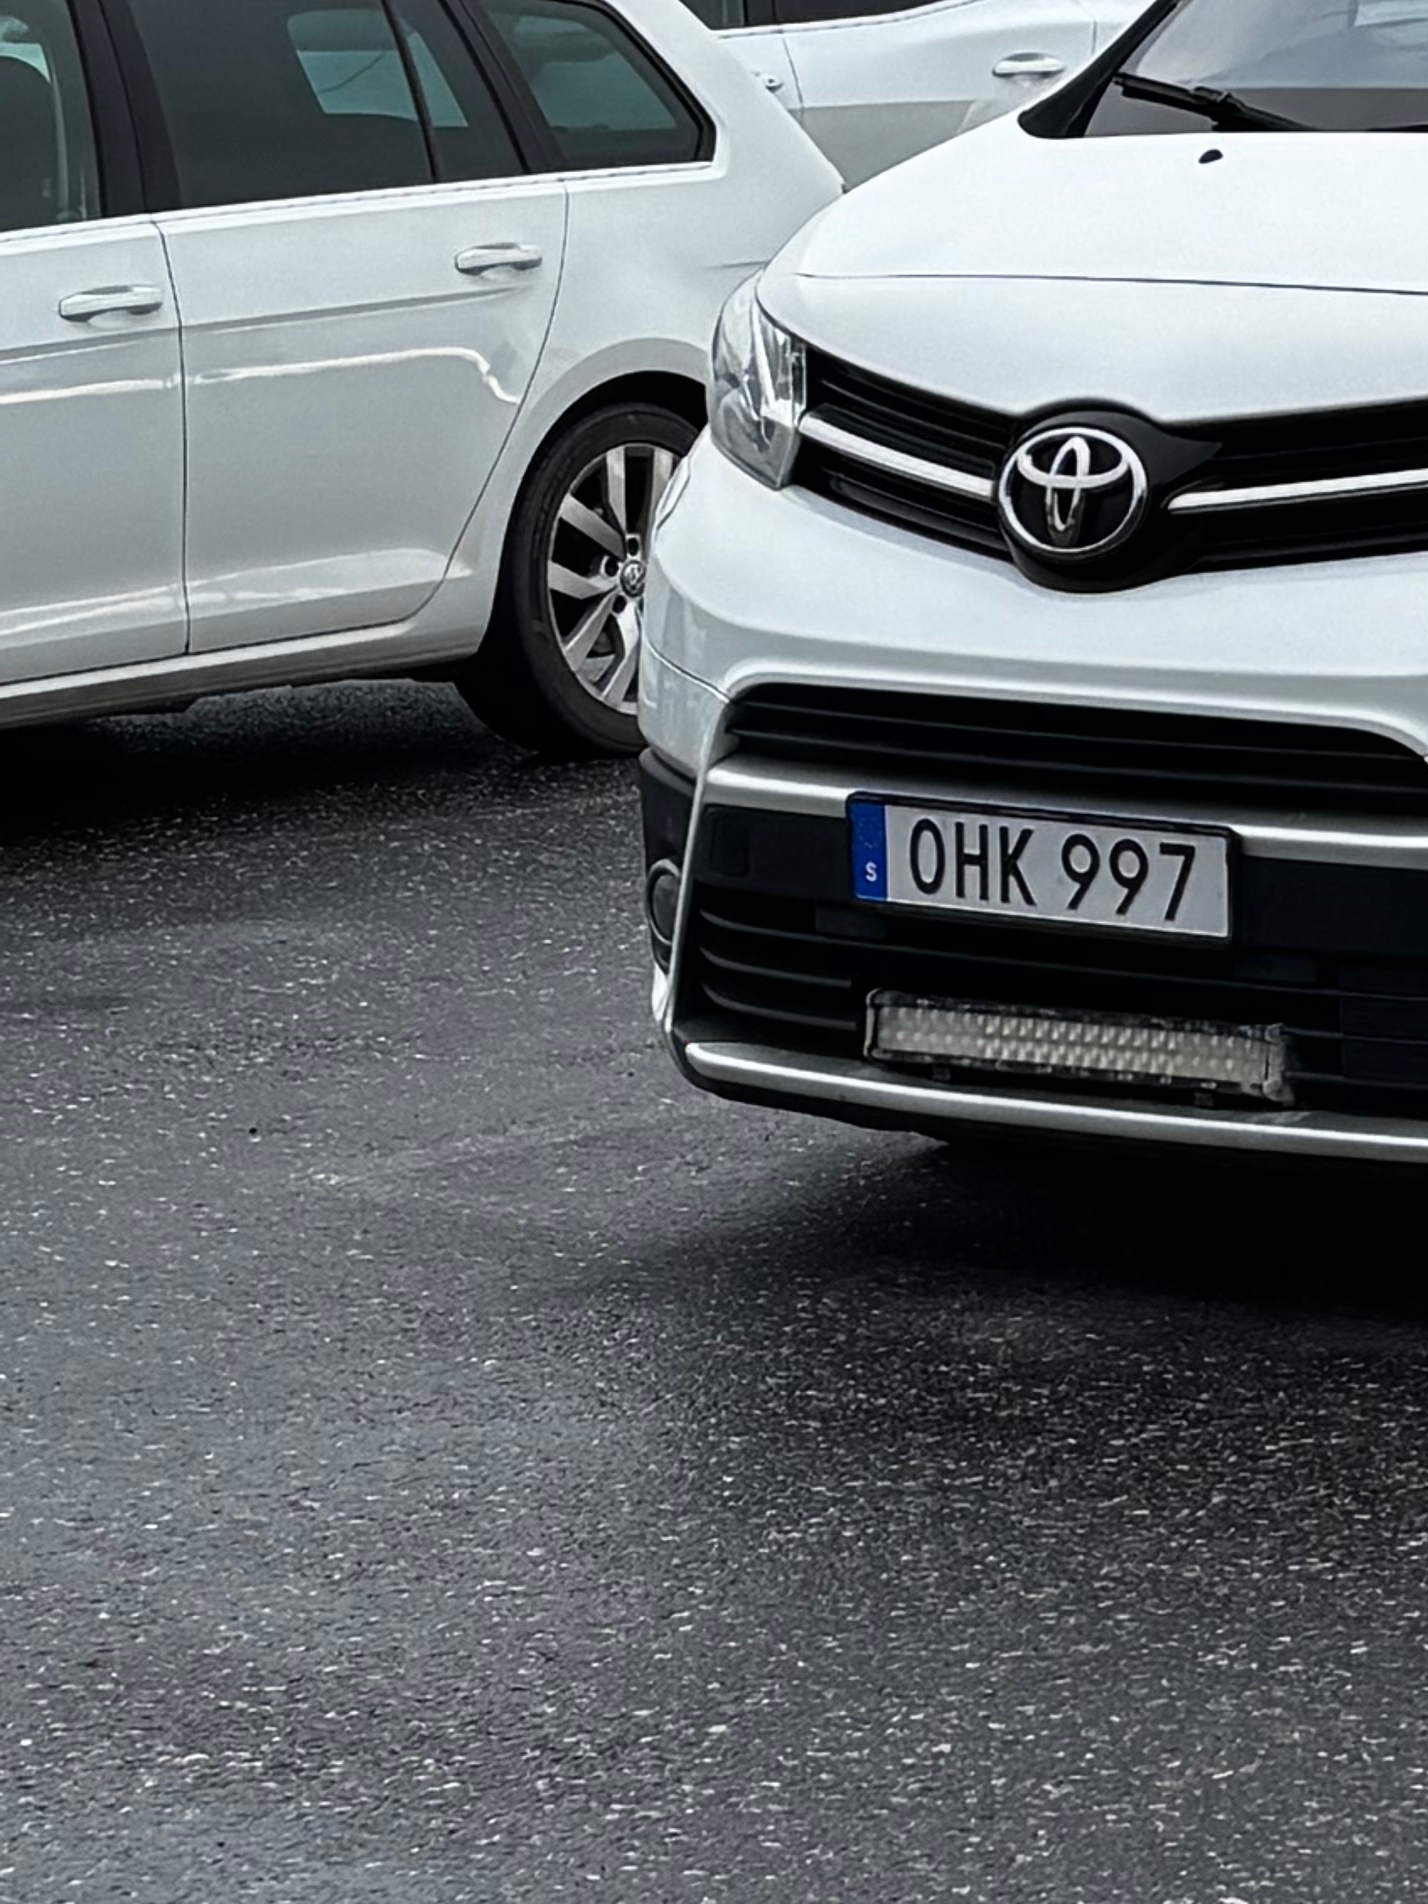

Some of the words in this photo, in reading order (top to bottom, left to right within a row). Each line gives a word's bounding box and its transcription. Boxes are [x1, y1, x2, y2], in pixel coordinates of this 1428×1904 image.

[864, 861, 878, 883] S
[909, 817, 1037, 907] OHK
[1061, 832, 1197, 922] 997
